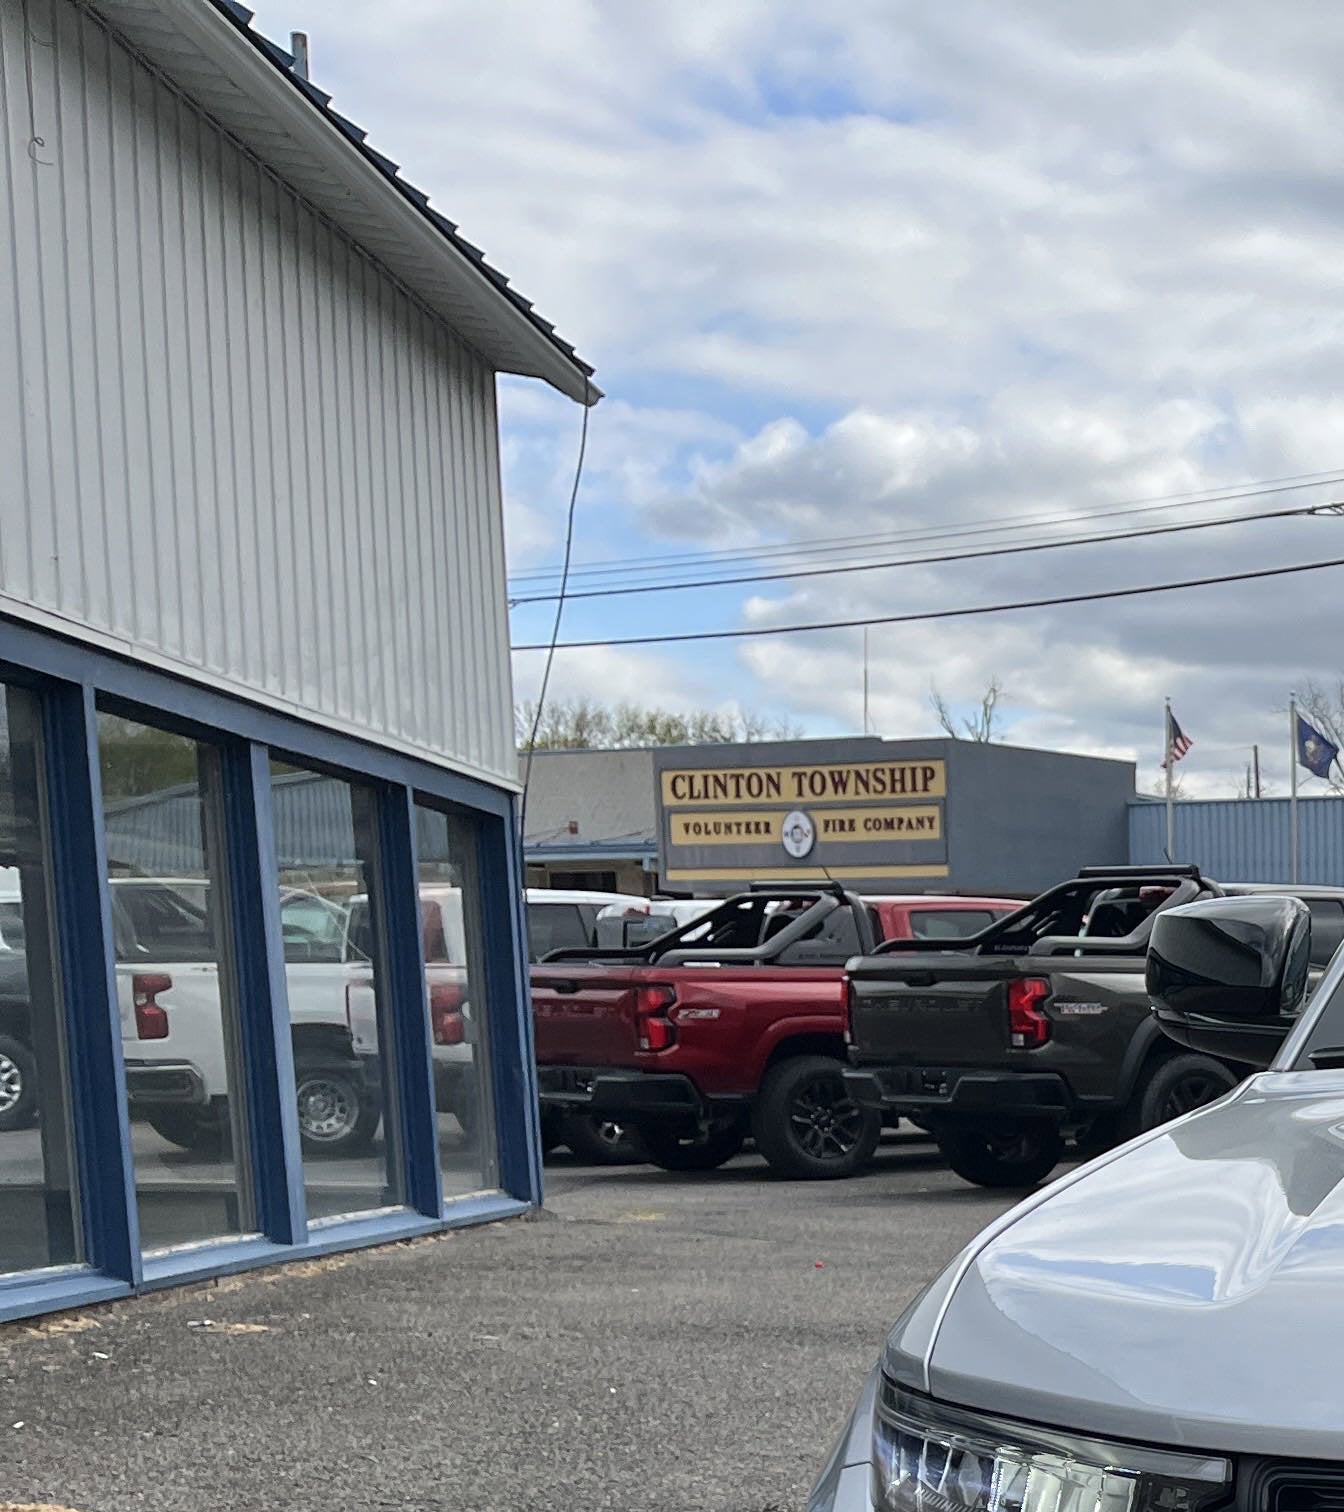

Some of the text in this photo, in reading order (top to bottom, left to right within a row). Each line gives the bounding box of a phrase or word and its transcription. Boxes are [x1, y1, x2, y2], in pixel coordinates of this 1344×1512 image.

[670, 766, 936, 800] CLINTON TOWNSHIP
[683, 815, 936, 835] VOLUNTEER FIRE COMPANY
